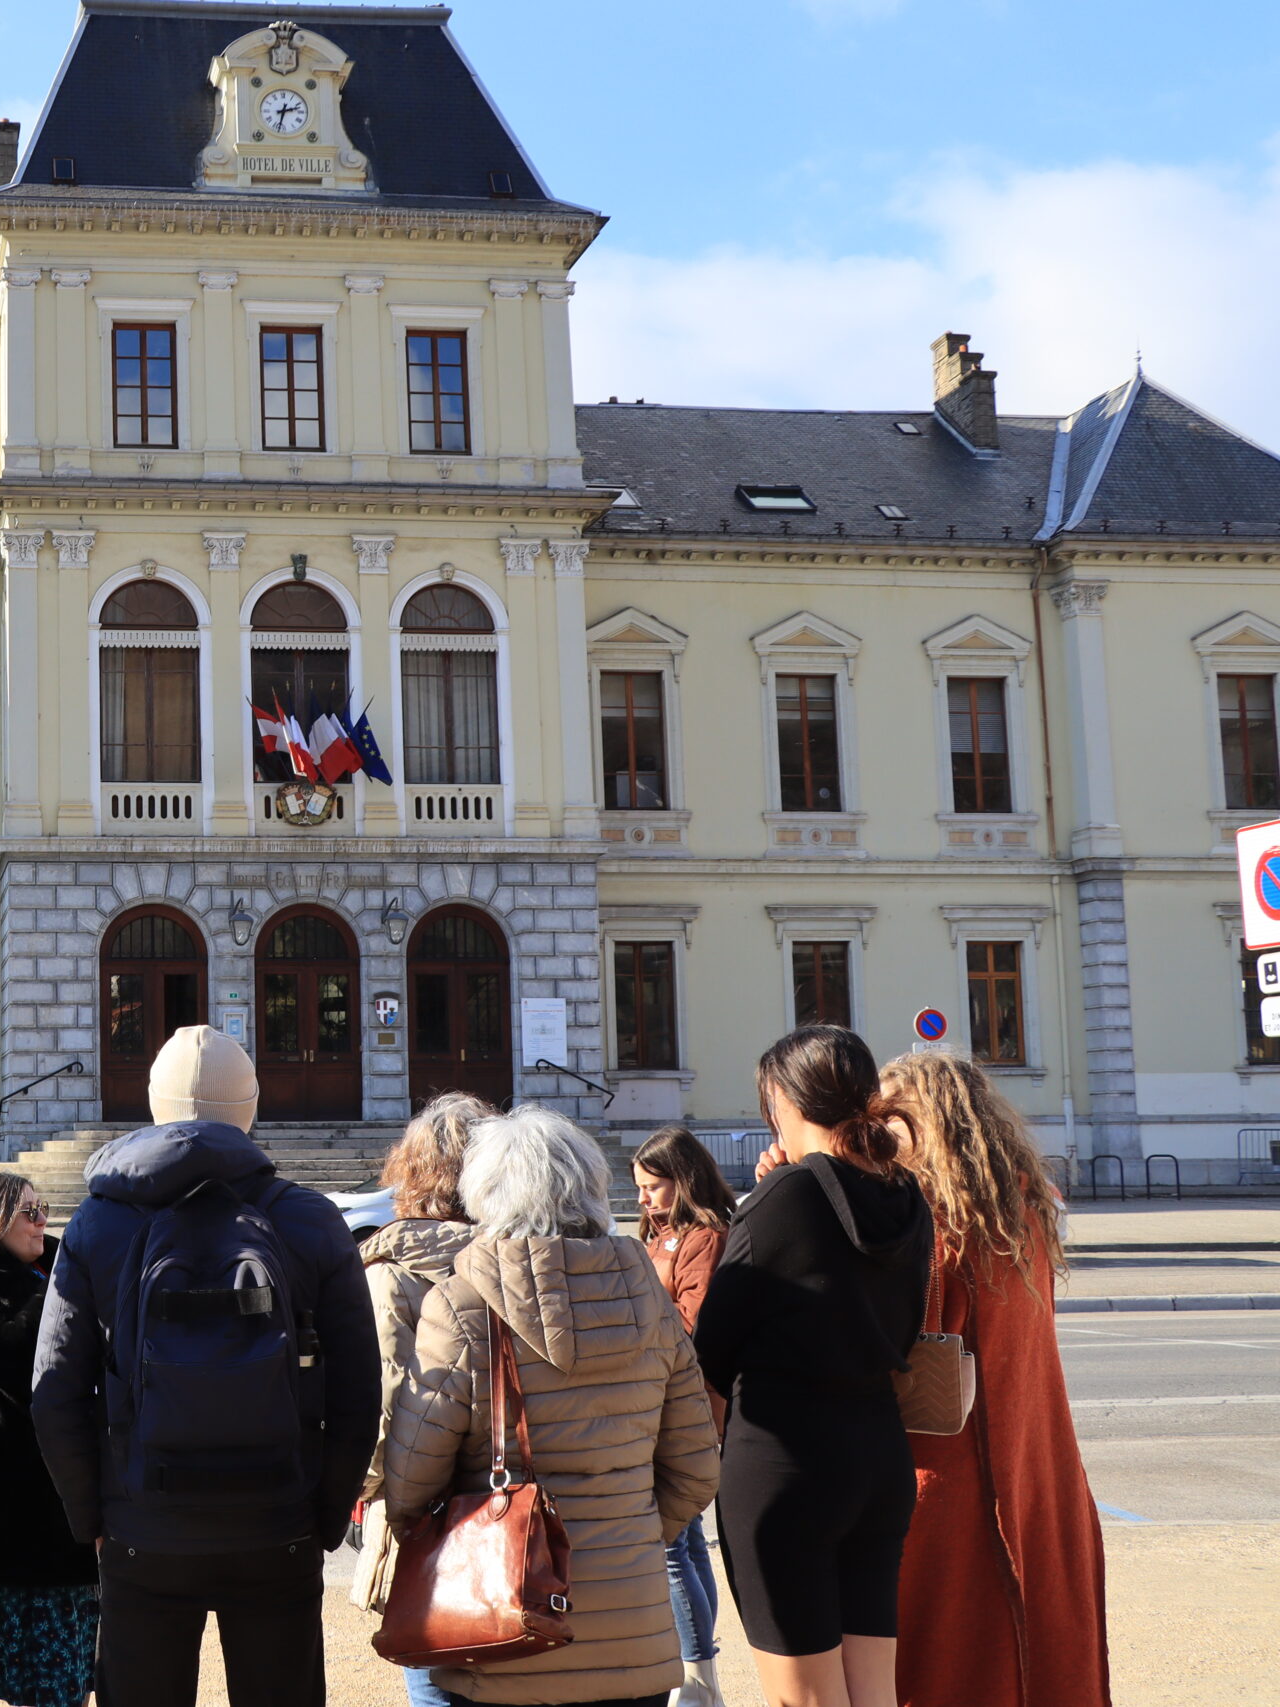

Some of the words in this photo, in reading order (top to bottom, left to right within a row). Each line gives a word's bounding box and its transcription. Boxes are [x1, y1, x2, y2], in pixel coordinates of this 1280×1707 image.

[242, 157, 278, 172] HOTEL
[281, 158, 295, 172] DE
[299, 159, 331, 173] VILLE
